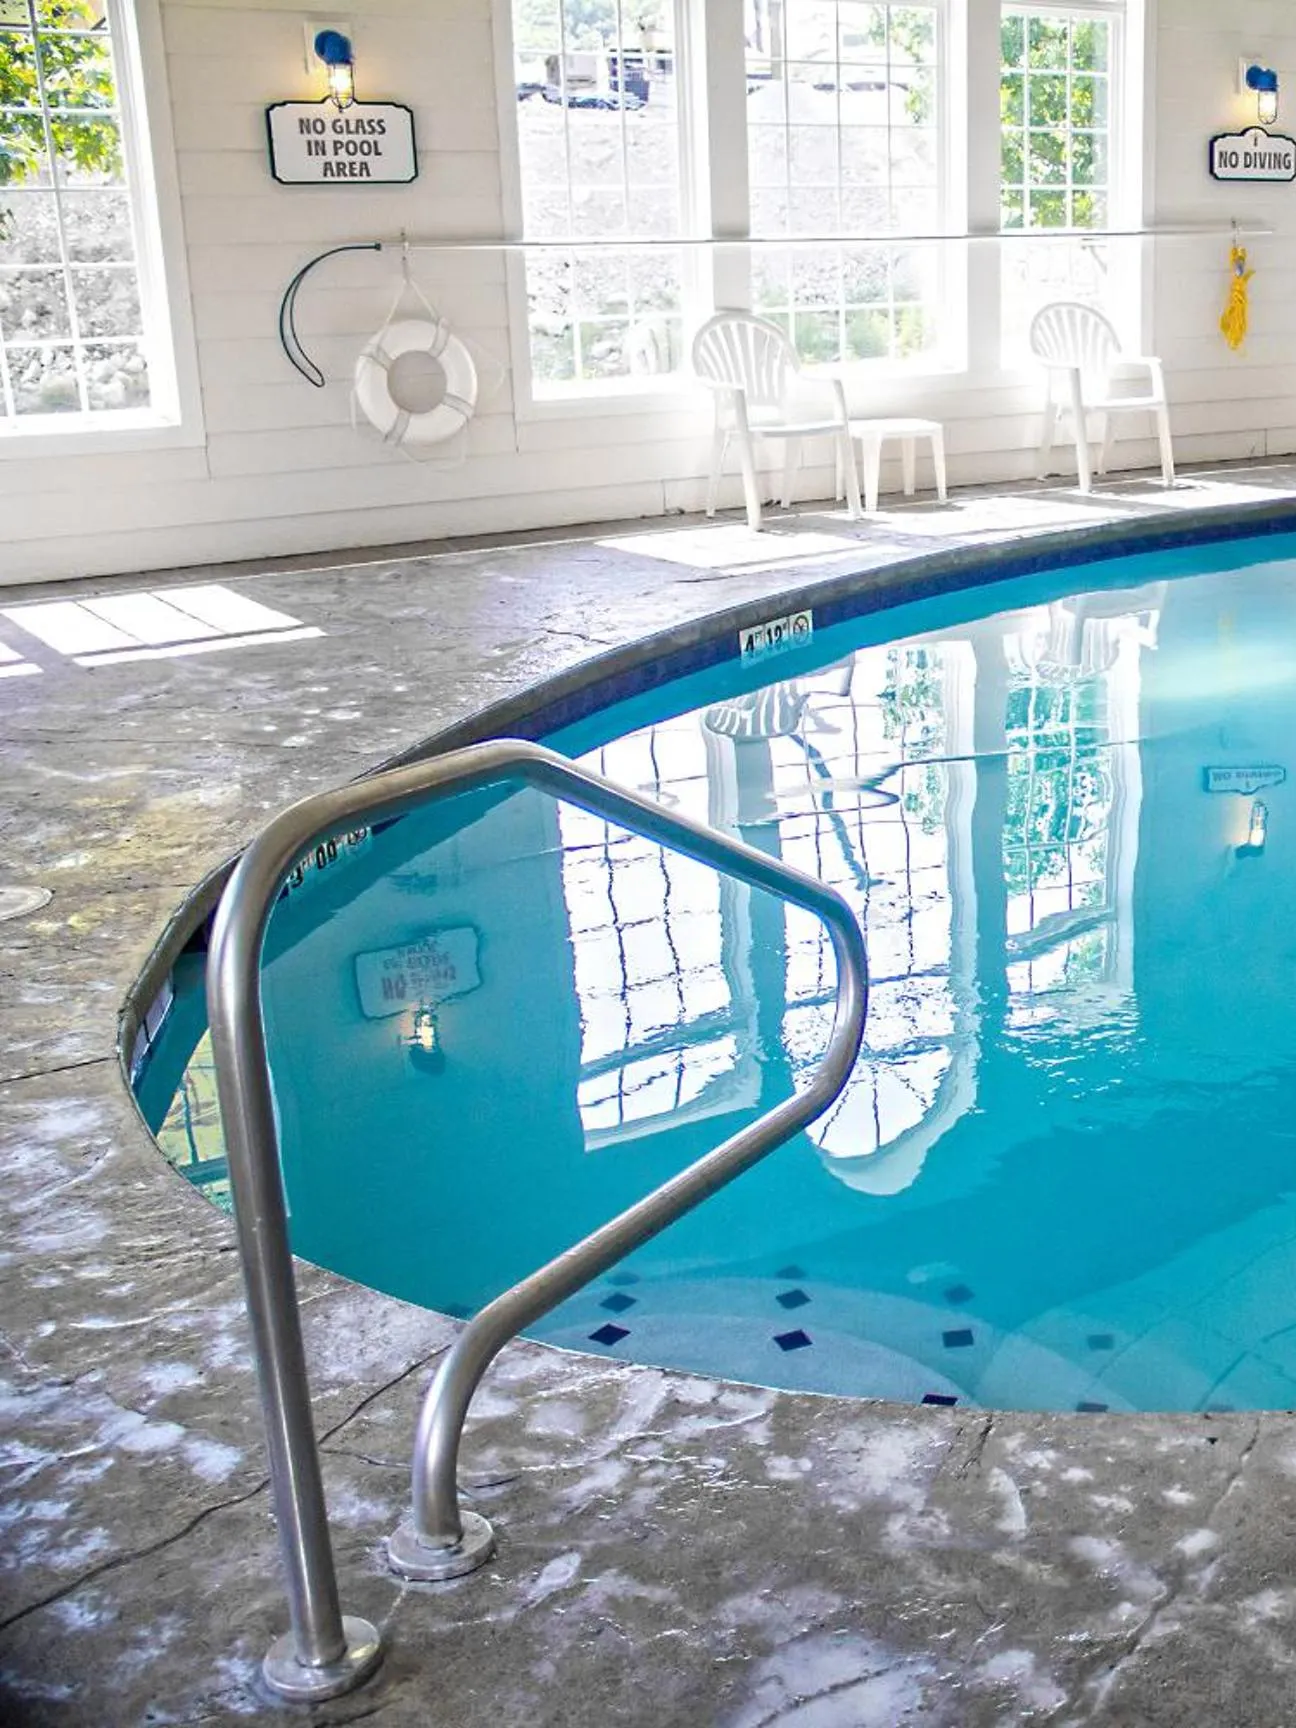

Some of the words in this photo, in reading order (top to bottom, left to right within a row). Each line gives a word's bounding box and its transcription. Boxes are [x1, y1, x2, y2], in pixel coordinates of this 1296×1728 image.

[298, 117, 326, 135] NO
[331, 118, 387, 136] GLASS
[306, 139, 327, 156] IN
[332, 139, 382, 157] POOL
[1218, 150, 1240, 169] NO
[1243, 151, 1292, 170] DIVING
[322, 161, 371, 178] AREA
